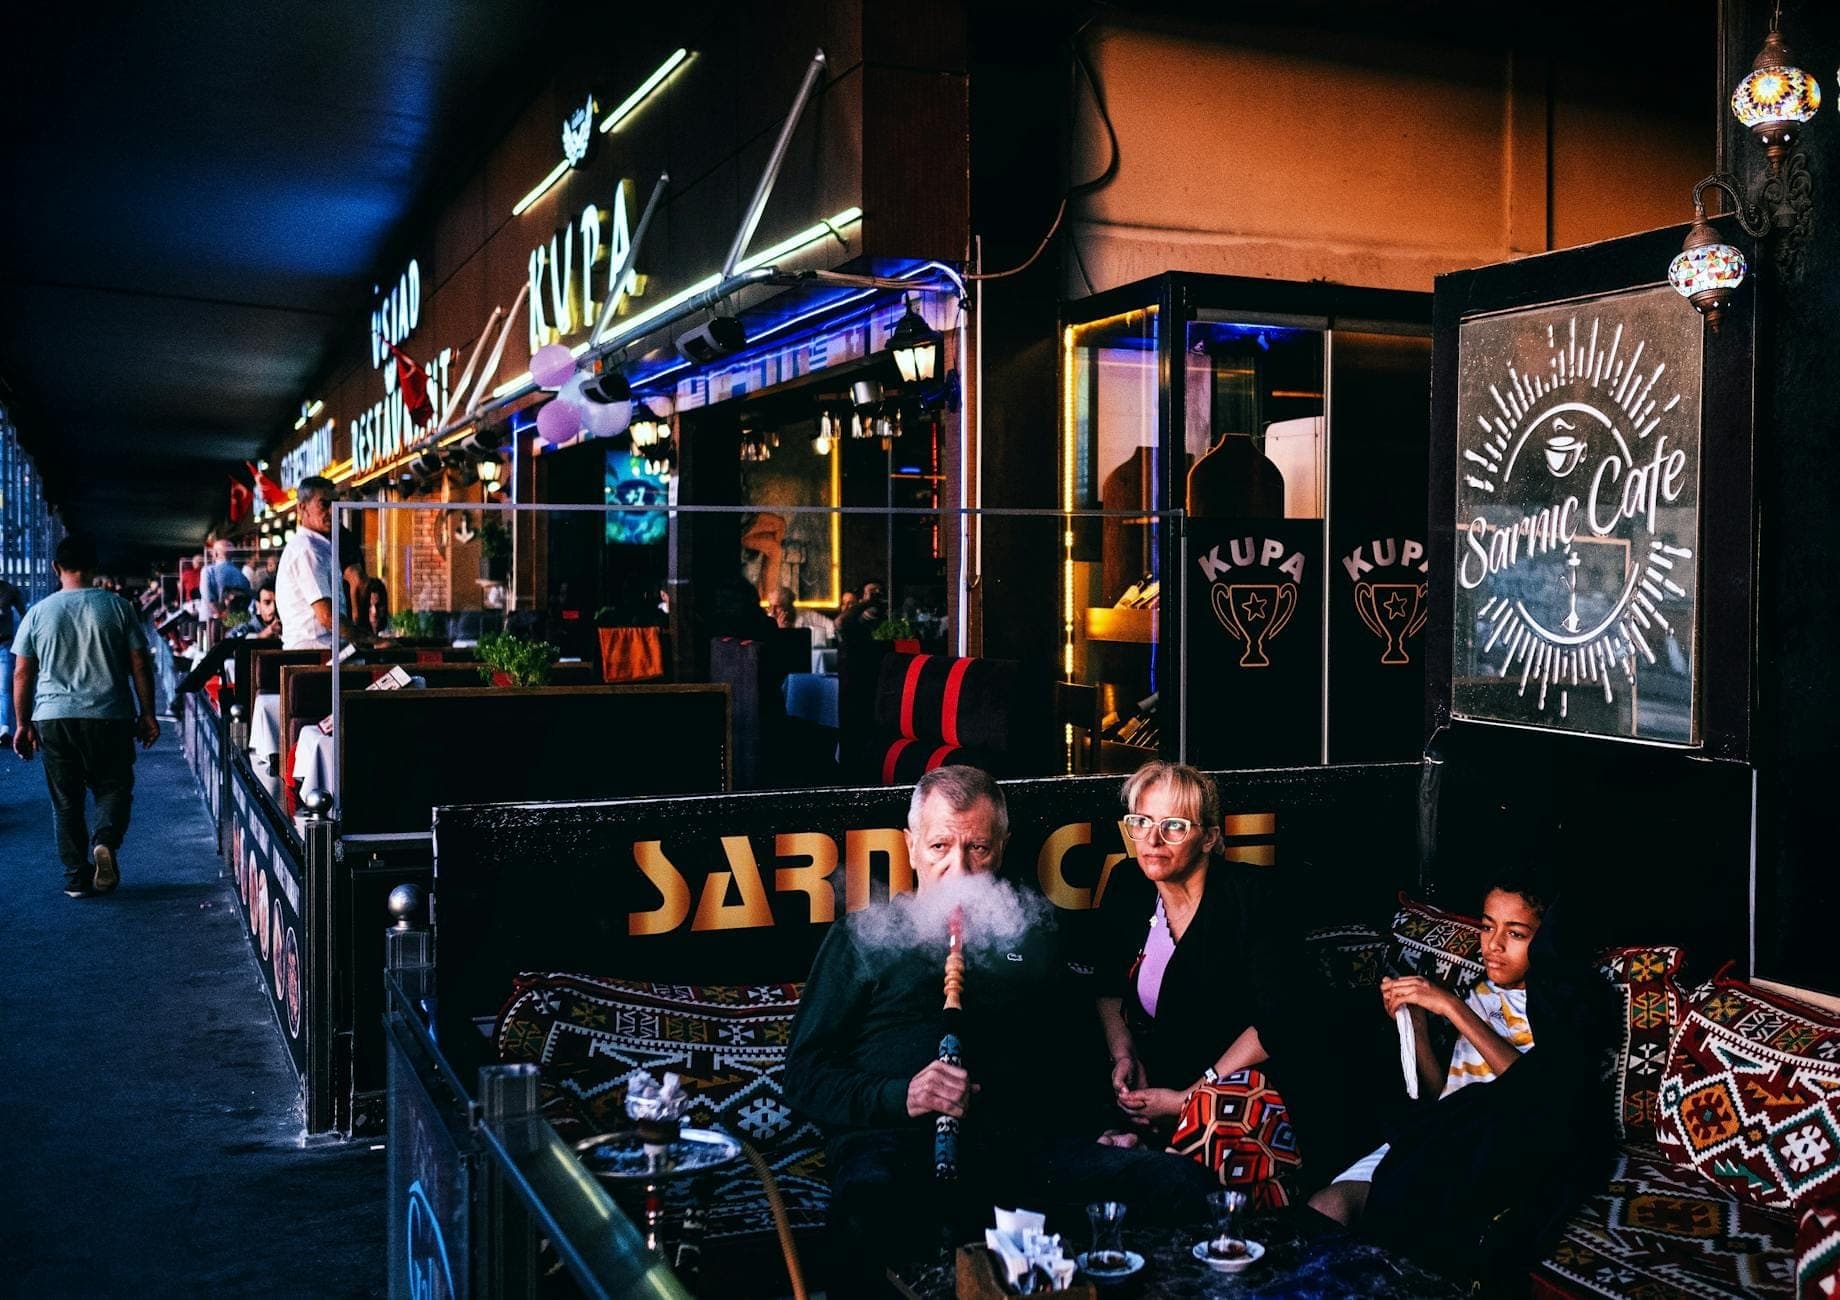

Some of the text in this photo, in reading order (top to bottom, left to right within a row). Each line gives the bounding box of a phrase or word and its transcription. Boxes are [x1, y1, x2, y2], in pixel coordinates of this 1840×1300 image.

[529, 178, 638, 355] KUPA
[352, 347, 451, 474] RESTAURNT
[1588, 436, 1686, 535] Cafe
[1198, 537, 1305, 583] KUPA
